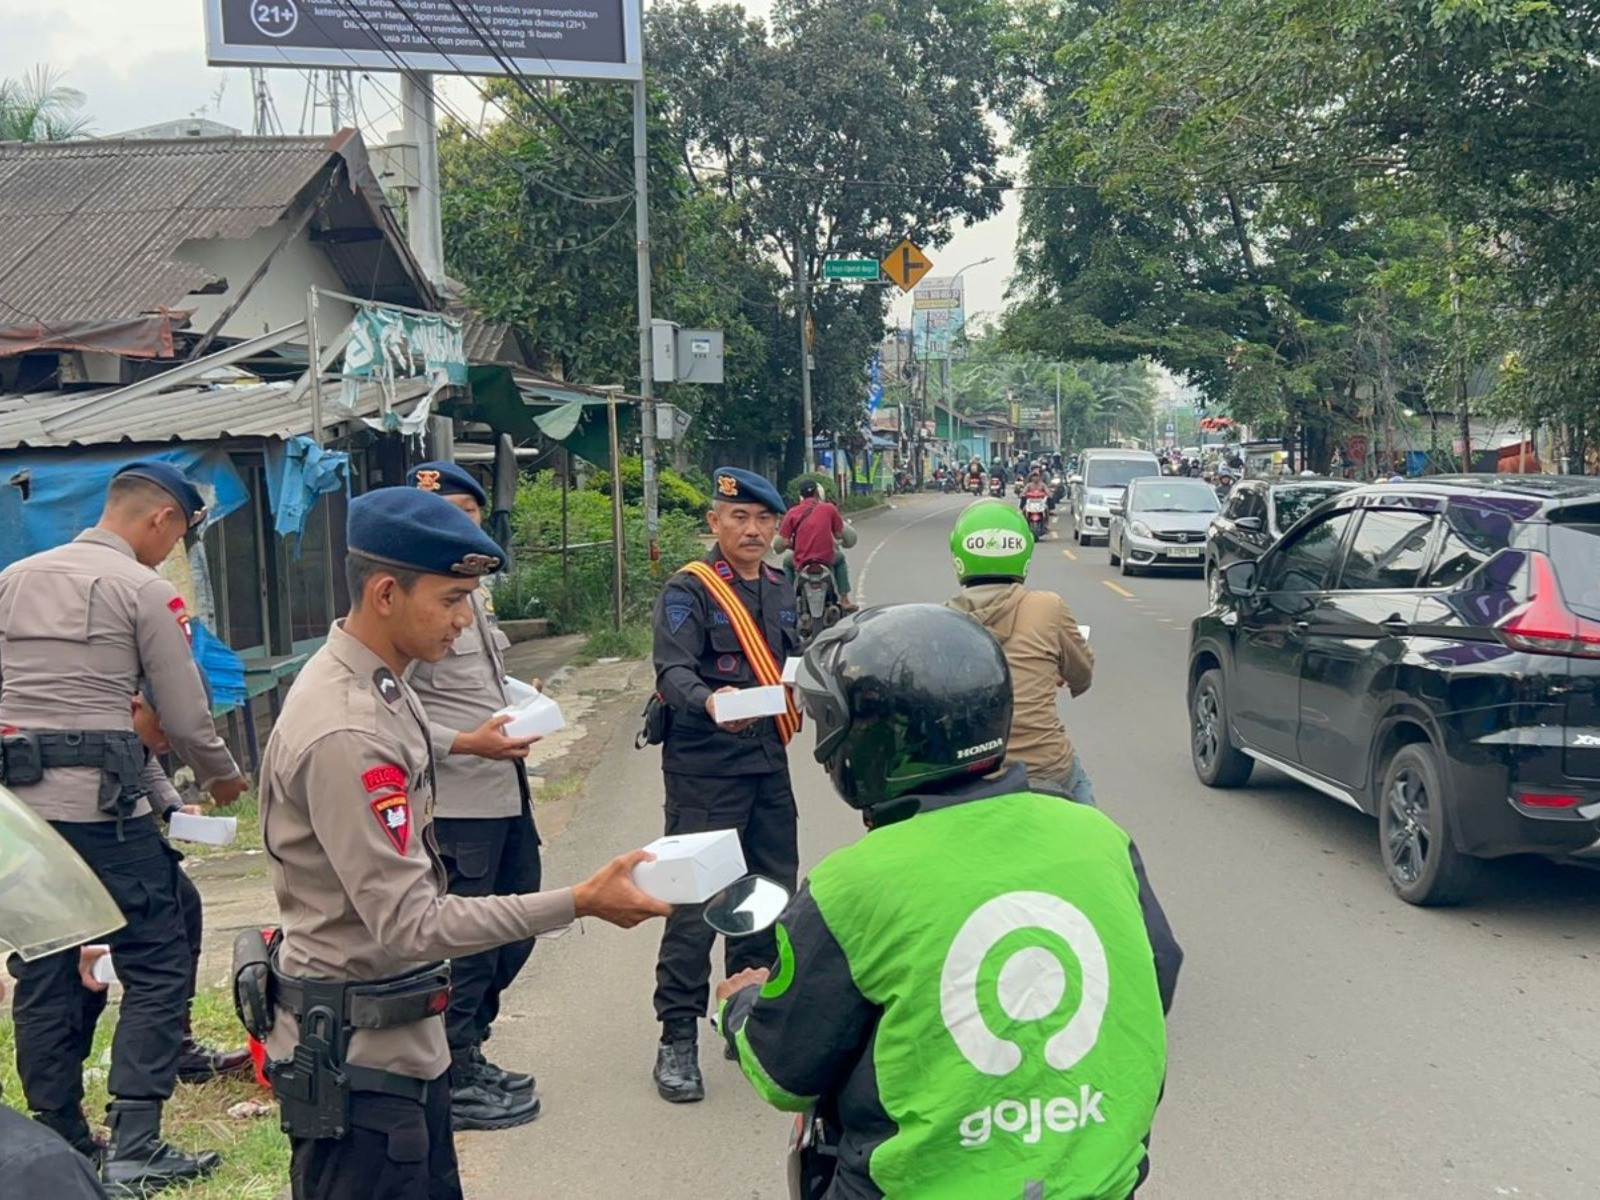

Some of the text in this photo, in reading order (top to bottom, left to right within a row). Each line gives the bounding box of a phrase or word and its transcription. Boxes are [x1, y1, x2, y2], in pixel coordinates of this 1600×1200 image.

[257, 5, 293, 23] 21+
[966, 537, 1024, 549] GO JEK
[957, 737, 1003, 759] HONDA
[959, 1084, 1106, 1148] gojek
